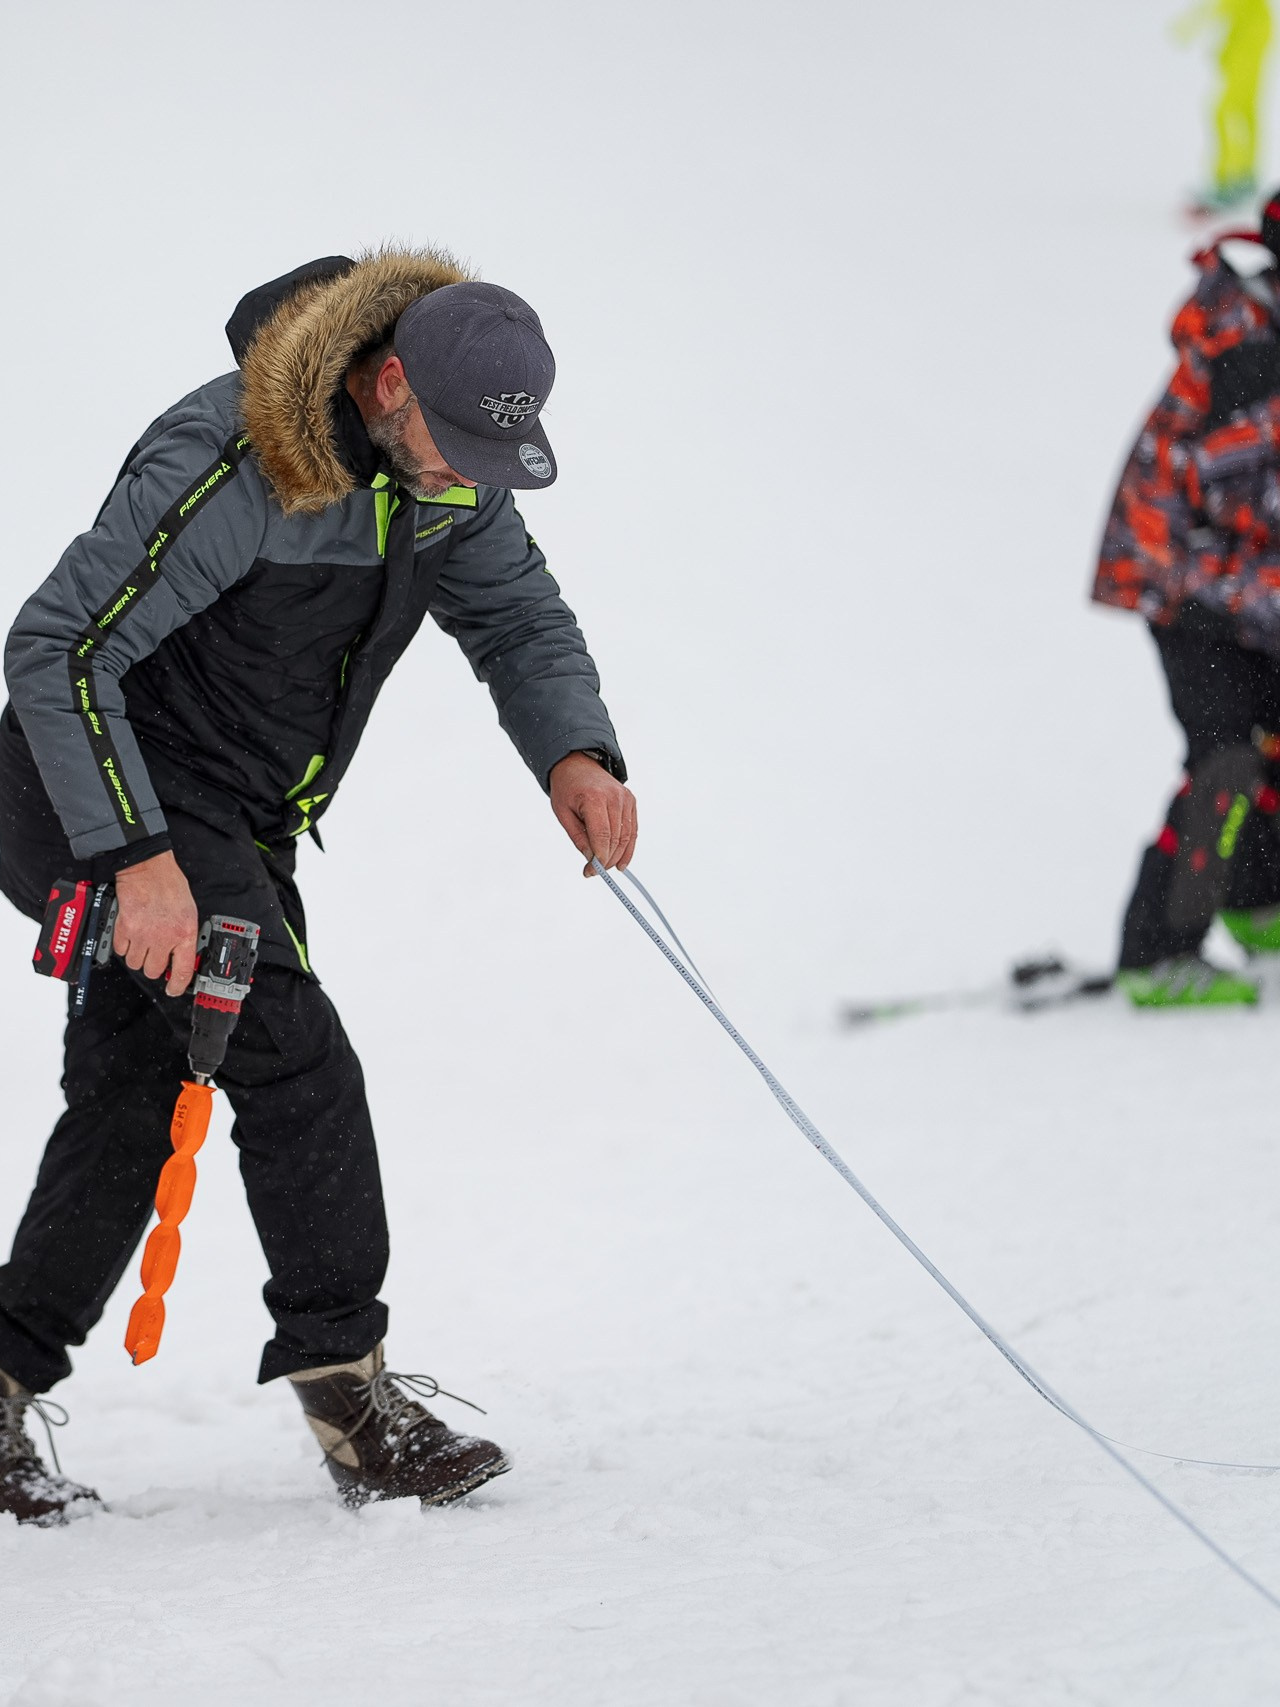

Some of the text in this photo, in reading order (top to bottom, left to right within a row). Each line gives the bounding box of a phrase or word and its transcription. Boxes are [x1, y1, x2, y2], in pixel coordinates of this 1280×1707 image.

[481, 398, 499, 410] WEST
[500, 402, 517, 414] FIELD
[180, 469, 223, 517] FISCHER
[108, 769, 136, 824] FISCHER
[54, 927, 71, 954] P.I.T.
